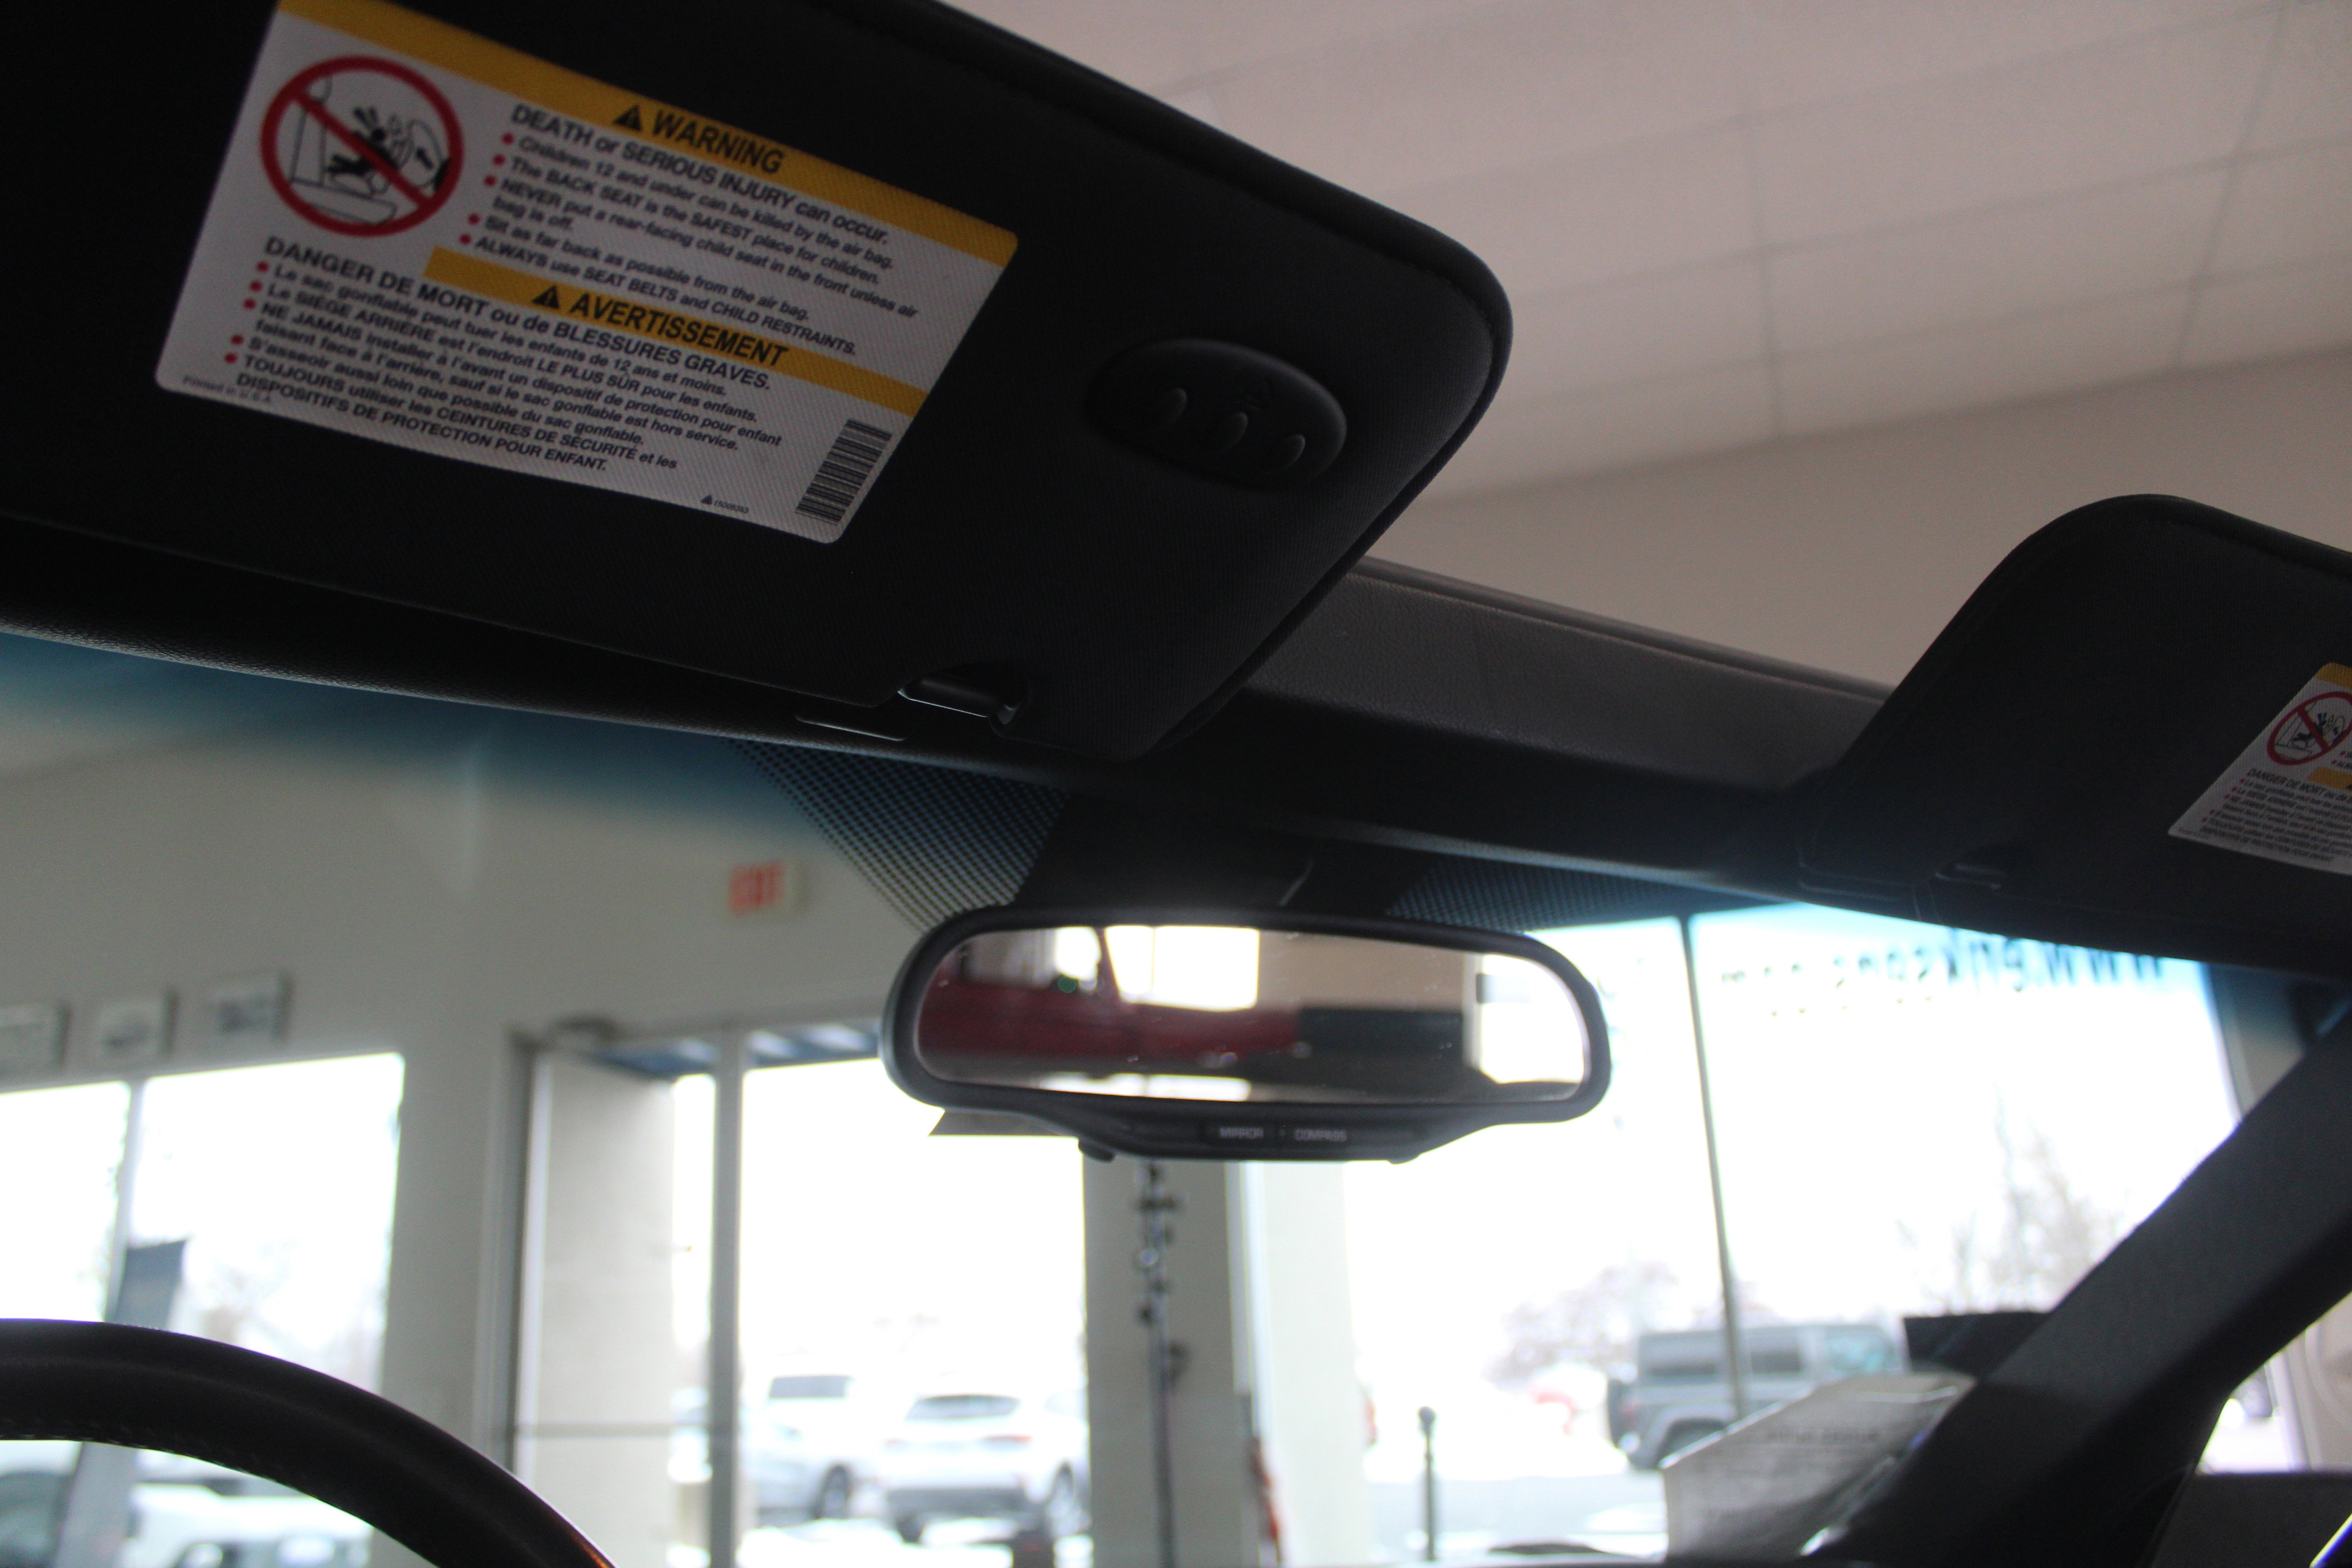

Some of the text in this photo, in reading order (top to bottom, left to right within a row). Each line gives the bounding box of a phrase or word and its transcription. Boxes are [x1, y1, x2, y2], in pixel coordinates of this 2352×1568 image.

[511, 104, 888, 245] DEATH or SERIOUS INJURY can occur.
[653, 109, 785, 174] WARNING
[493, 196, 527, 220] bag
[528, 208, 545, 223] is
[501, 178, 918, 318] NEVER put a rear-facing child seat in the front unless air
[512, 156, 879, 285] The BACK SEAT is the SAFEST place for children.
[518, 136, 893, 270] Children 12 and under can be killed by the air bag.
[265, 237, 770, 390] DANGER DE MORT ou de BLESSURES GRAVES.
[475, 236, 855, 356] ALWAYS use SEAT BELTS and CHILD RESTRAINTS.
[485, 215, 809, 321] Sit as far back as possible from the air bag.
[262, 302, 289, 320] NE
[292, 313, 363, 341] JAMAIS
[366, 332, 433, 361] installer
[451, 356, 506, 380] l'avant
[508, 373, 529, 385] un
[532, 377, 603, 401] dispositif
[604, 394, 623, 406] de
[624, 400, 699, 424] protection
[700, 418, 736, 433] pour
[737, 428, 782, 446] enfant
[267, 283, 290, 300] Le
[438, 336, 466, 351] est
[467, 341, 535, 368] l'endroit
[536, 359, 559, 374] LE
[560, 364, 605, 384] PLUS
[606, 368, 643, 392] SÛR
[640, 386, 677, 401] pour
[678, 392, 700, 407] les
[703, 401, 757, 422] enfants.
[274, 264, 298, 282] Le
[421, 312, 462, 330] peut
[465, 321, 498, 340] tuer
[500, 331, 524, 347] les
[528, 341, 586, 362] enfants
[589, 354, 609, 367] de
[614, 359, 632, 372] 12
[633, 365, 660, 379] ans
[662, 373, 679, 383] et
[680, 377, 726, 396] moins.
[569, 293, 789, 366] AVERTISSEMENT
[236, 373, 607, 470] DISPOSITIFS DE PROTECTION POUR ENFANT.
[245, 355, 677, 469] TOUJOURS utiliser les CEINTURES DE SÉCURITÉ et les
[334, 363, 381, 383] aussi
[382, 374, 414, 393] loin
[417, 386, 448, 402] que
[450, 395, 518, 417] possible
[521, 410, 542, 423] du
[544, 416, 572, 429] sac
[574, 423, 644, 450] gonflable.
[448, 376, 486, 392] sauf
[487, 385, 503, 396] si
[504, 387, 519, 400] le
[522, 393, 550, 407] sac
[552, 400, 623, 422] gonflable
[625, 416, 649, 428] est
[650, 419, 683, 436] hors
[685, 430, 738, 450] service.
[1219, 1127, 1264, 1139] MIRROR
